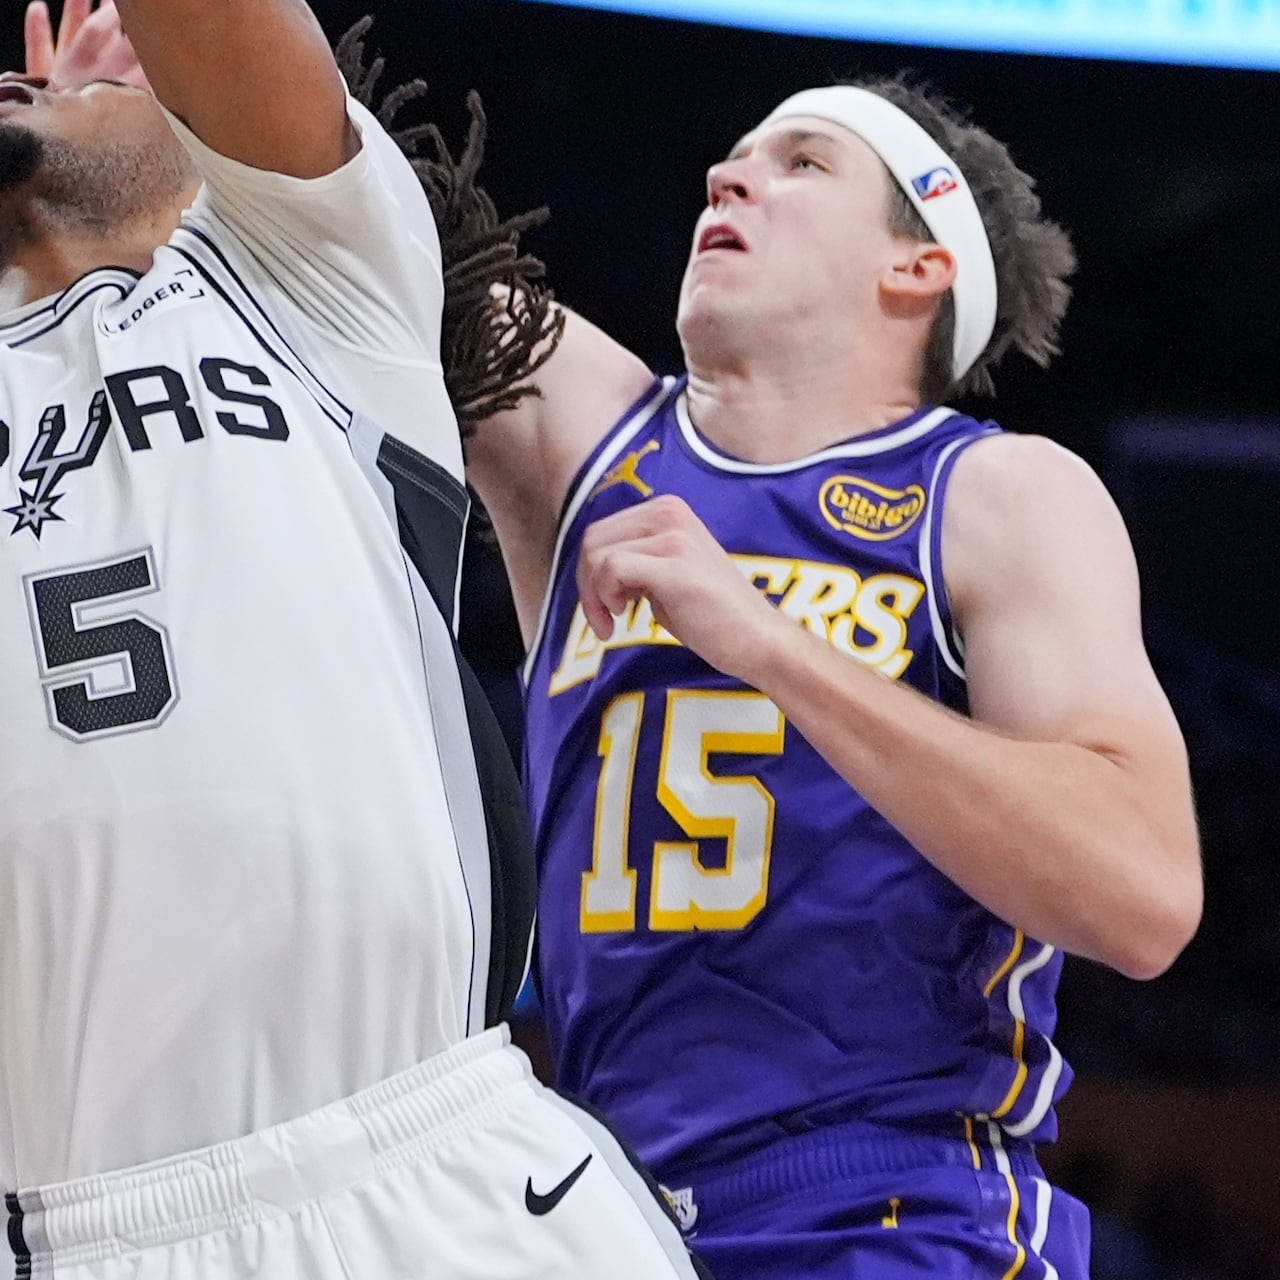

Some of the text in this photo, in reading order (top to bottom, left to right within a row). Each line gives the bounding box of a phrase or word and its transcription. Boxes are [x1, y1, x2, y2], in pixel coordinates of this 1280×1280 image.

[830, 483, 920, 528] bibigo
[21, 544, 183, 744] 5
[580, 688, 785, 934] 15
